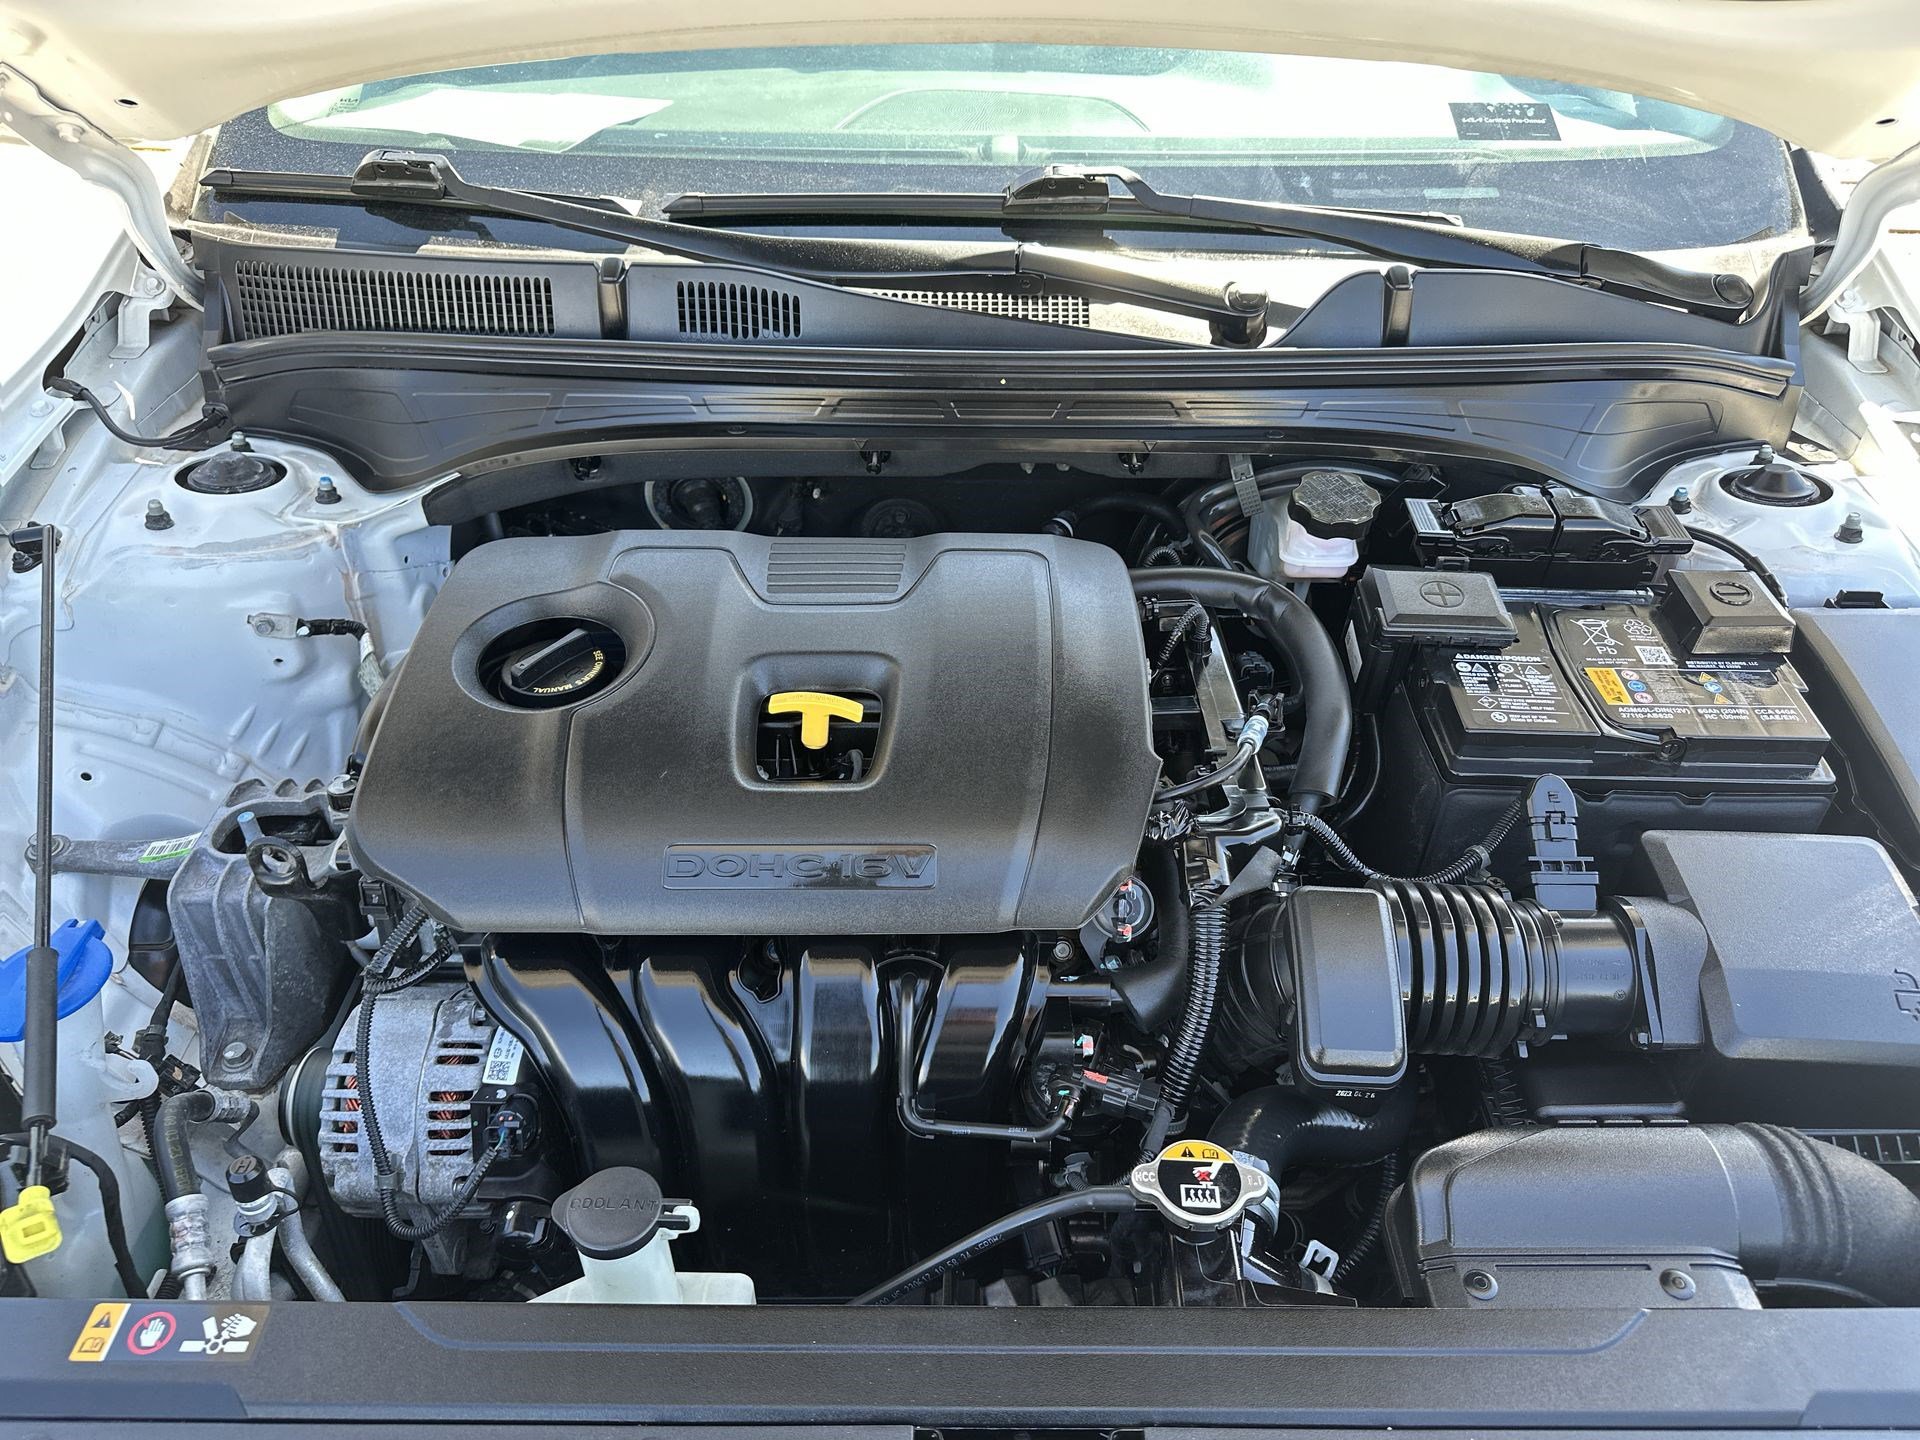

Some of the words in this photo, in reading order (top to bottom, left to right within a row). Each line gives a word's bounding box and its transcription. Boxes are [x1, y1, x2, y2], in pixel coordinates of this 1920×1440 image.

[593, 650, 604, 661] SEE
[1596, 646, 1617, 655] Pb
[533, 683, 573, 694] MANUAL
[666, 853, 826, 878] DOHC
[838, 853, 934, 879] 16V
[570, 1197, 658, 1212] COOLANT
